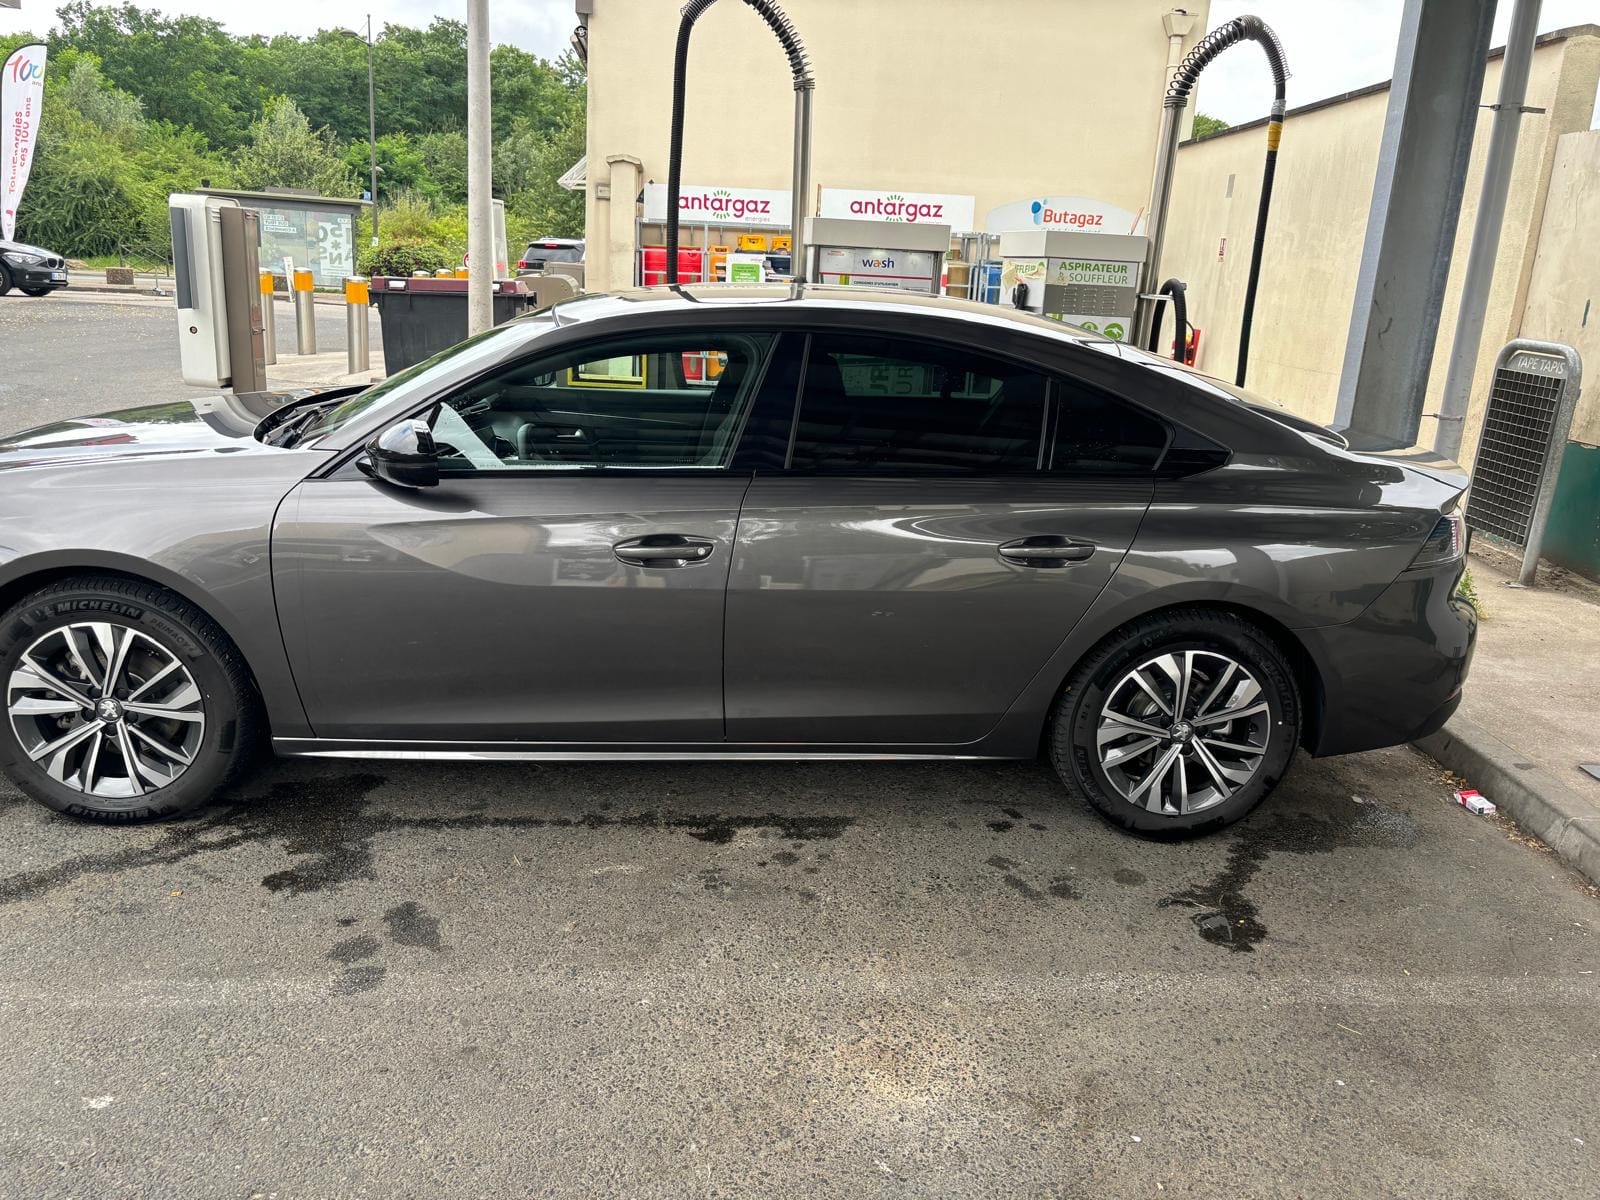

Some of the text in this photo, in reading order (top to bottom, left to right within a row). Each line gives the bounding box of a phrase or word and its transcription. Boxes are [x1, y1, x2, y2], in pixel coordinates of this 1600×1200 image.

[677, 190, 771, 218] antargaz
[850, 198, 943, 222] antargaz
[1042, 208, 1104, 228] Butagaz
[1059, 261, 1128, 274] ASPIRATEUR
[1068, 272, 1128, 285] SOUFFLEUR
[1517, 356, 1566, 374] TAPE TAPIS
[57, 600, 141, 618] MICHELIN
